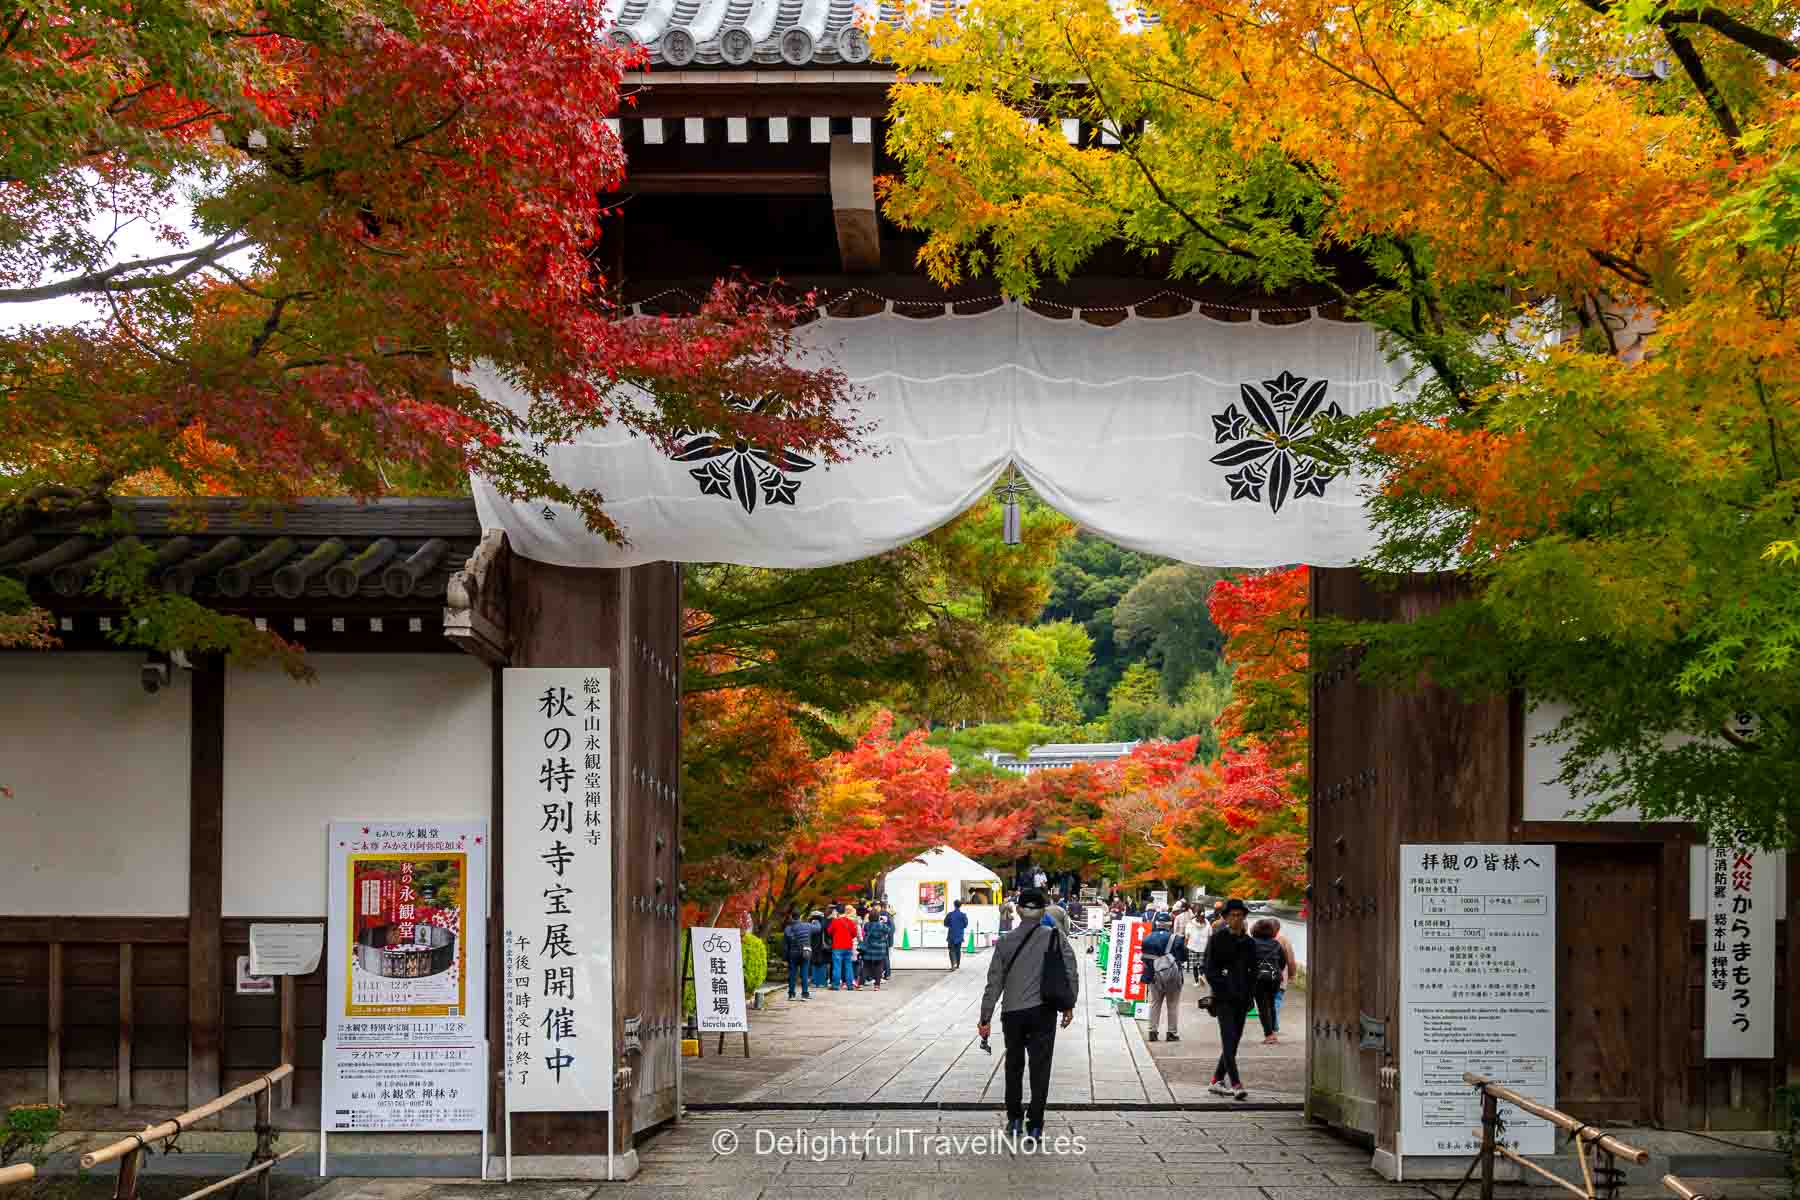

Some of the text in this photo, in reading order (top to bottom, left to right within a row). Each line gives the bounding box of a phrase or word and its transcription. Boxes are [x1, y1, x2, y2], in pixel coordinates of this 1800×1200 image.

[583, 677, 601, 846] 総本山永観堂禅林寺
[399, 861, 415, 939] 秋の永観堂
[538, 686, 577, 1086] 秋の特別寺宝展開催中
[1421, 852, 1541, 872] 拝観の皆様へ
[515, 935, 532, 1086] 午後四時受付終了
[710, 957, 730, 1015] 駐輪場
